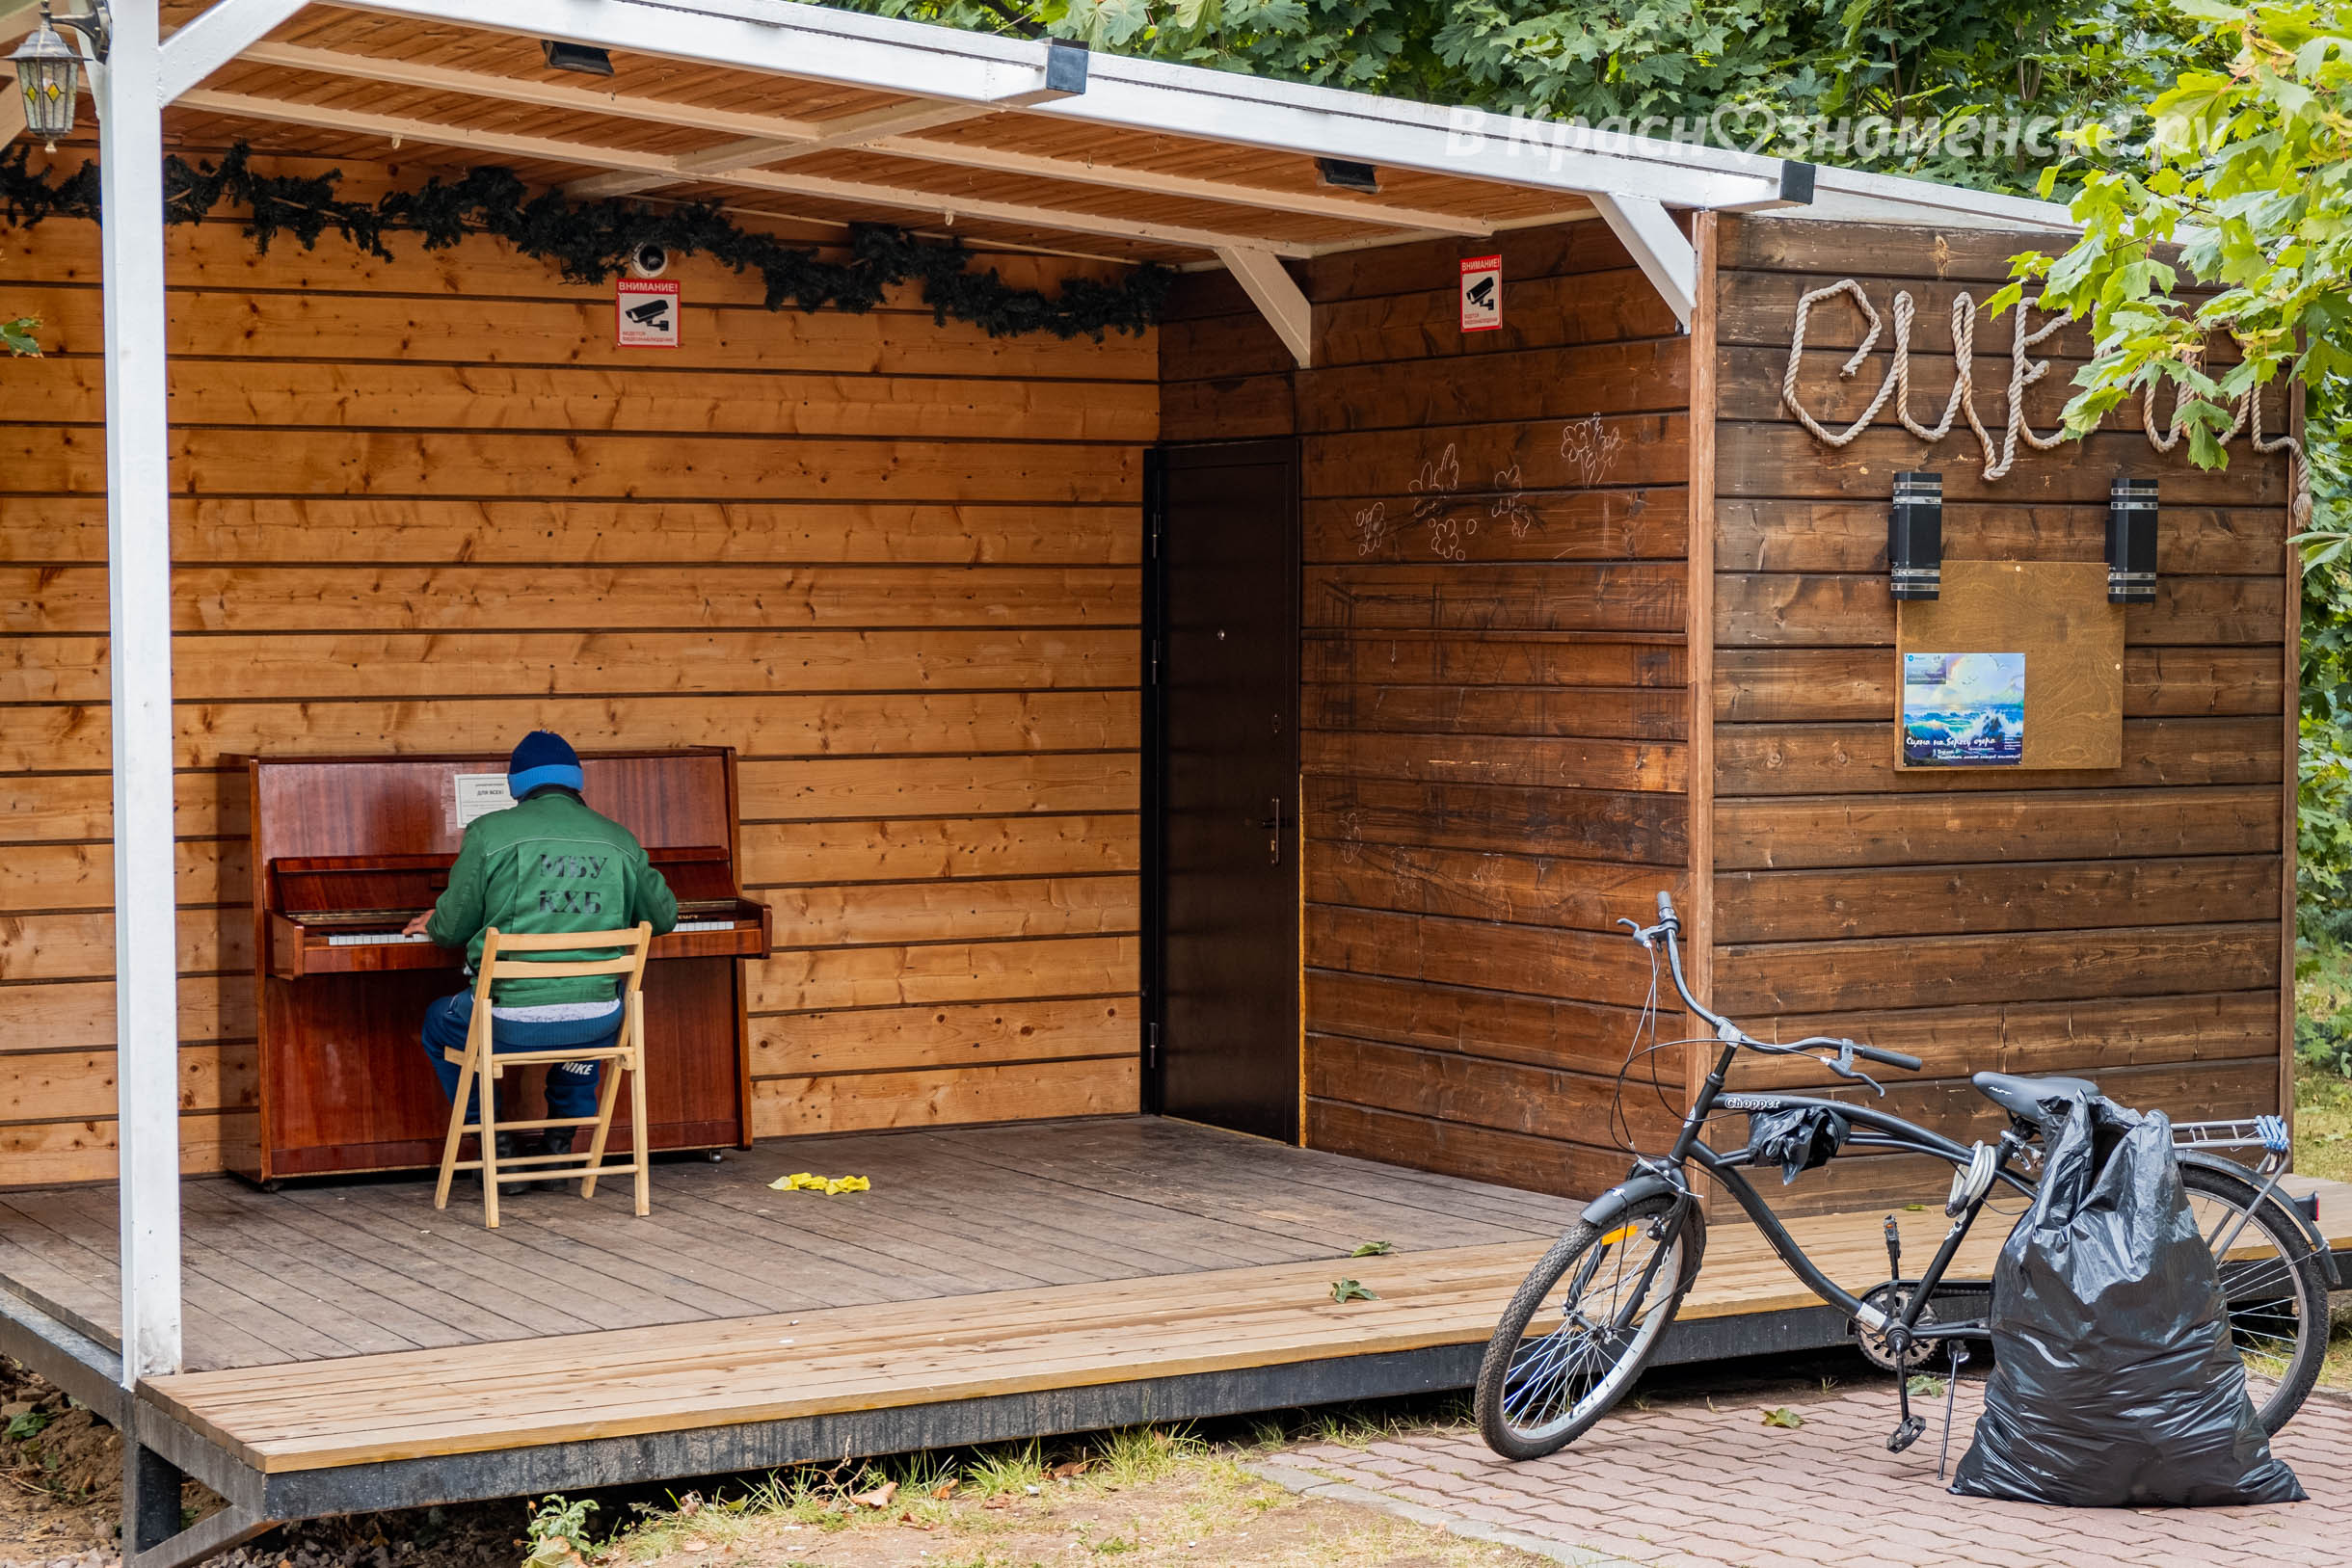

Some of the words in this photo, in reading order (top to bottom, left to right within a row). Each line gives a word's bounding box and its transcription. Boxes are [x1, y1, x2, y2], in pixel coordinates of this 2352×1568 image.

[1461, 257, 1500, 271] ВНИМАНИЕ!
[618, 281, 679, 293] ВНИМАНИЕ!
[1933, 738, 1945, 747] на
[539, 854, 609, 880] МБУ
[539, 890, 602, 914] КХБ
[562, 1061, 594, 1076] NIKE
[1724, 1097, 1780, 1111] Chopper
